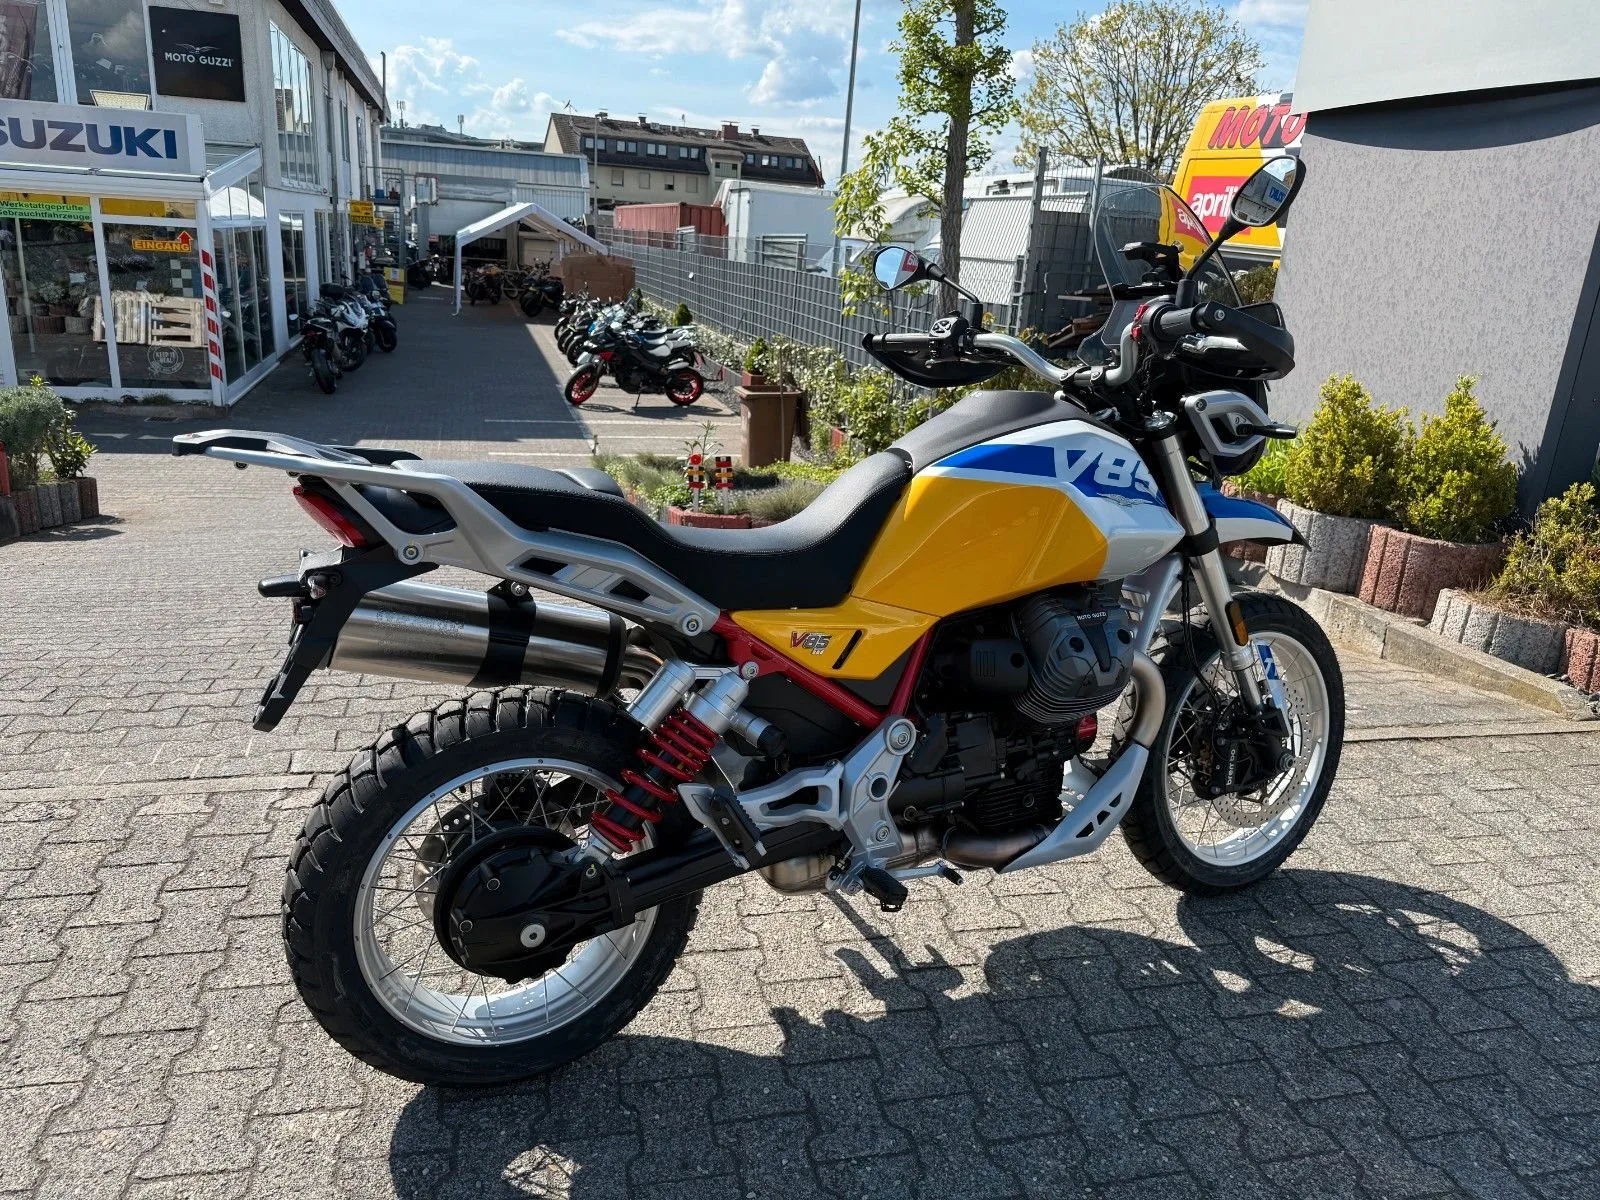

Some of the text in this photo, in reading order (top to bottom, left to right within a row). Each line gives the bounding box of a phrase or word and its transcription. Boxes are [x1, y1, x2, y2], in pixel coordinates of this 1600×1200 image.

[165, 52, 232, 67] MOTO GUZZI
[0, 116, 178, 160] UZUKI
[0, 201, 84, 211] Werkstattgeprüfte
[1191, 186, 1239, 221] april
[0, 209, 90, 220] ebrauchtfahrzeuge
[134, 240, 190, 251] EINGANG
[790, 631, 832, 649] V85
